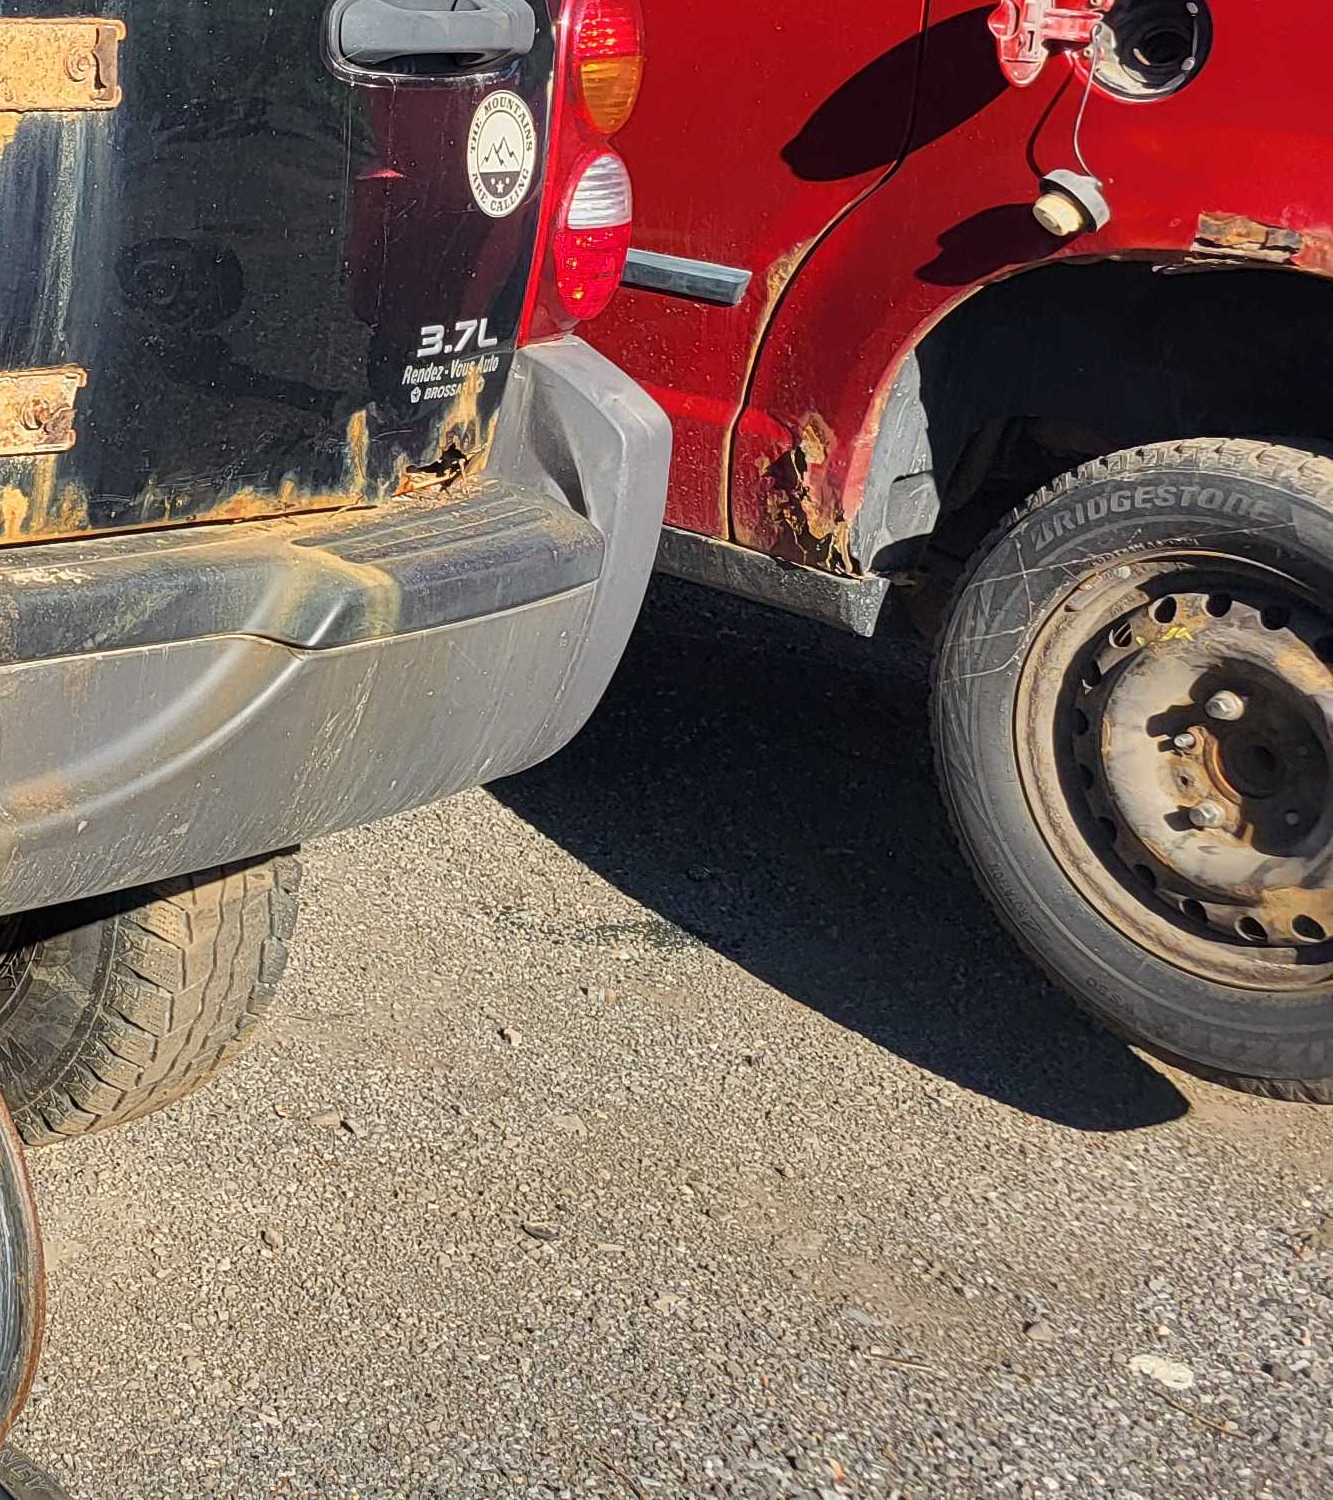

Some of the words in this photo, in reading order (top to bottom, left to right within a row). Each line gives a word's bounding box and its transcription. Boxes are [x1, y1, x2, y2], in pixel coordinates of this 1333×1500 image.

[470, 118, 483, 154] THE
[484, 97, 533, 152] MOUNTAINS
[472, 172, 487, 205] ARE
[490, 168, 529, 212] CALLING
[416, 317, 498, 358] 3.7L
[1030, 485, 1278, 551] BRIDGESTONE
